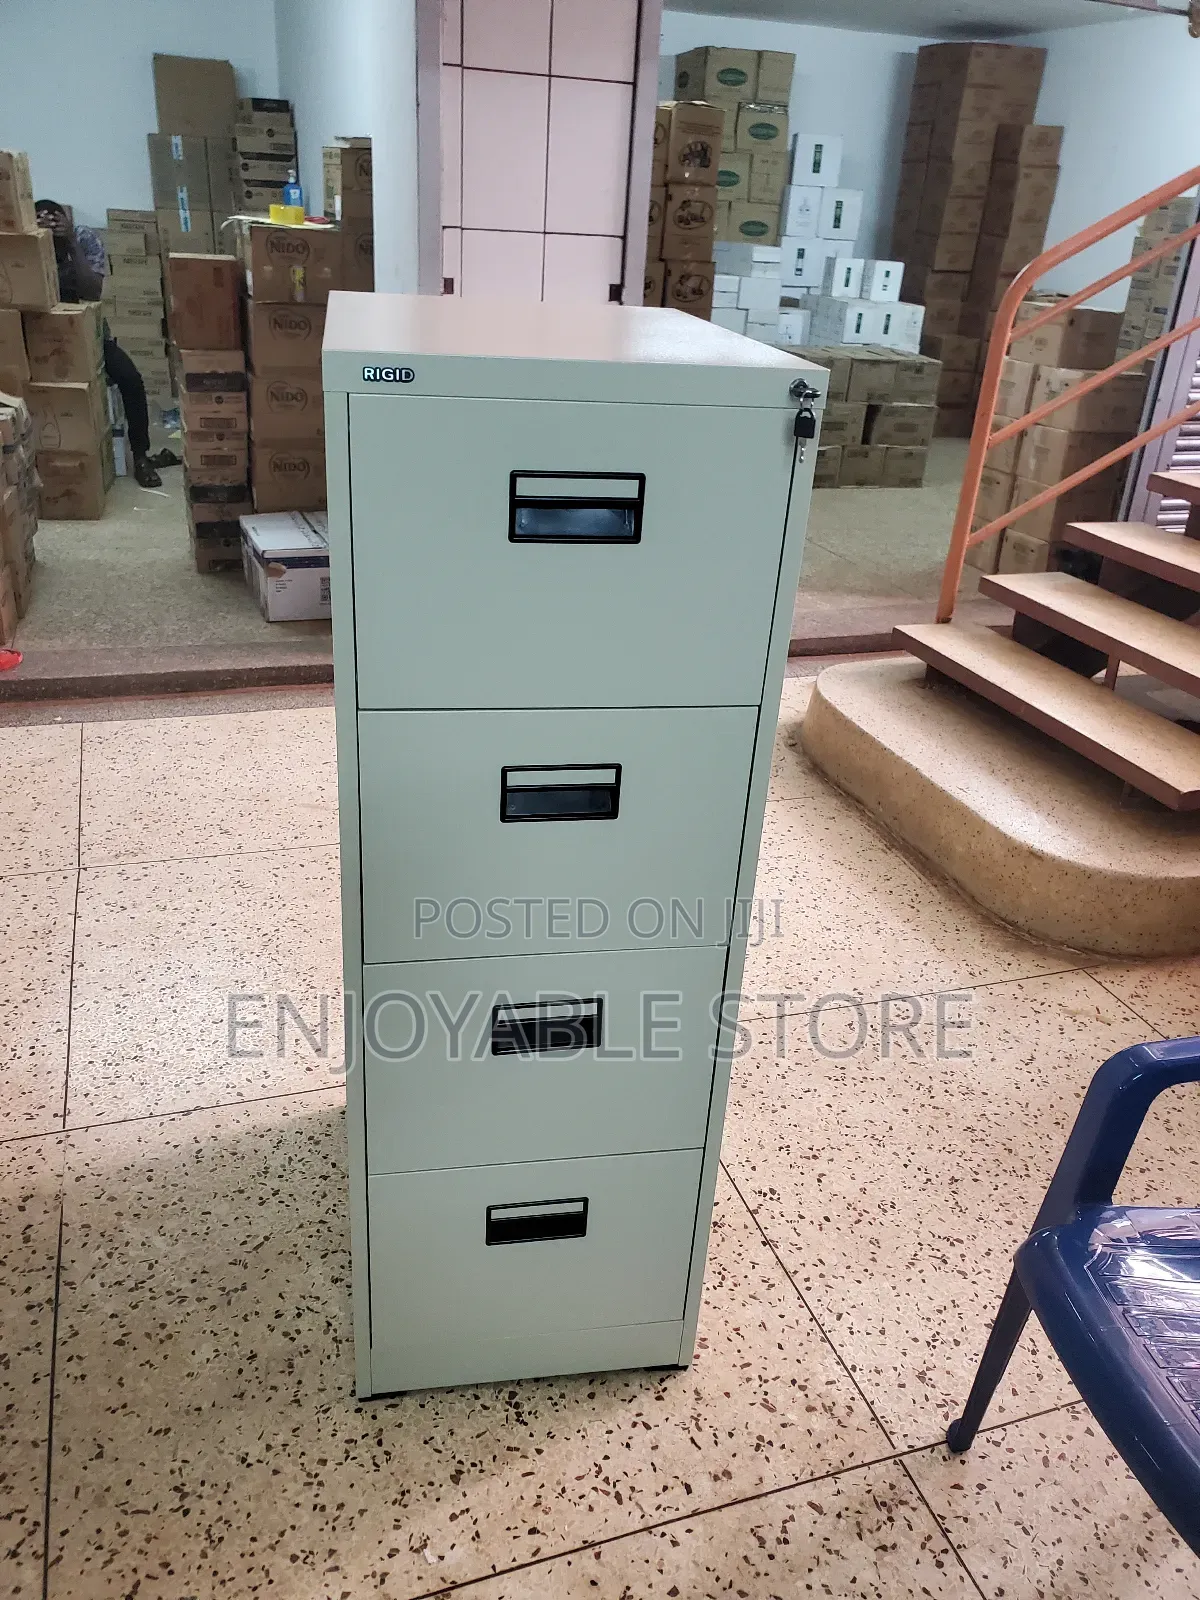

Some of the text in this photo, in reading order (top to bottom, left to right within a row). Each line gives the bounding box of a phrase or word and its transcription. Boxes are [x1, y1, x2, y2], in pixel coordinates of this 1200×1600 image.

[269, 237, 307, 253] NIDO
[272, 316, 308, 331] NIDO
[362, 366, 415, 383] RIGID
[269, 389, 306, 403] NIDO
[272, 458, 308, 473] NIDO
